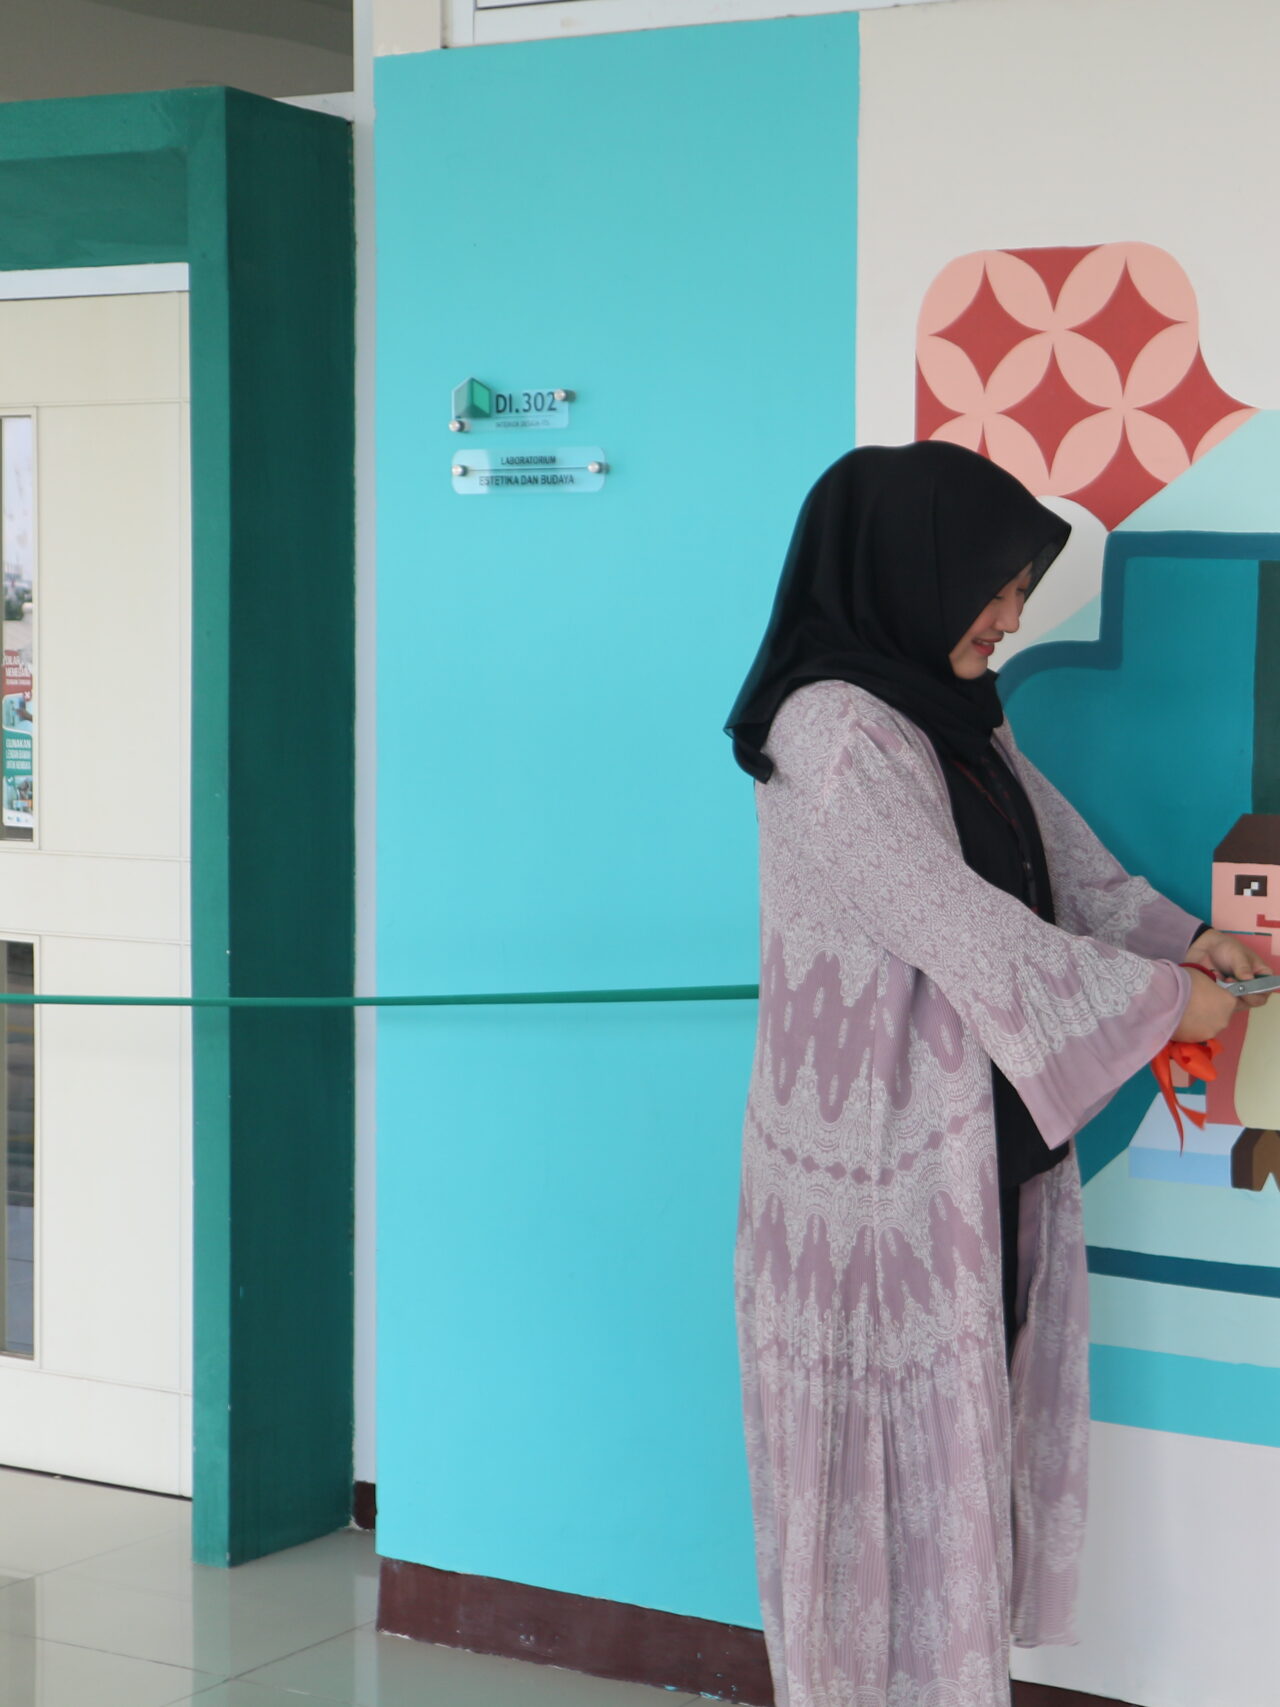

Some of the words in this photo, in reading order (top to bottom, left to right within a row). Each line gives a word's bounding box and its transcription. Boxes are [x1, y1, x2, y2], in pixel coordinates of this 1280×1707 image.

[495, 392, 557, 414] DI.302
[501, 455, 557, 465] LABORATORIUM
[479, 476, 519, 487] ESTETIKA
[520, 475, 539, 486] DAN
[541, 474, 575, 485] BUDAYA
